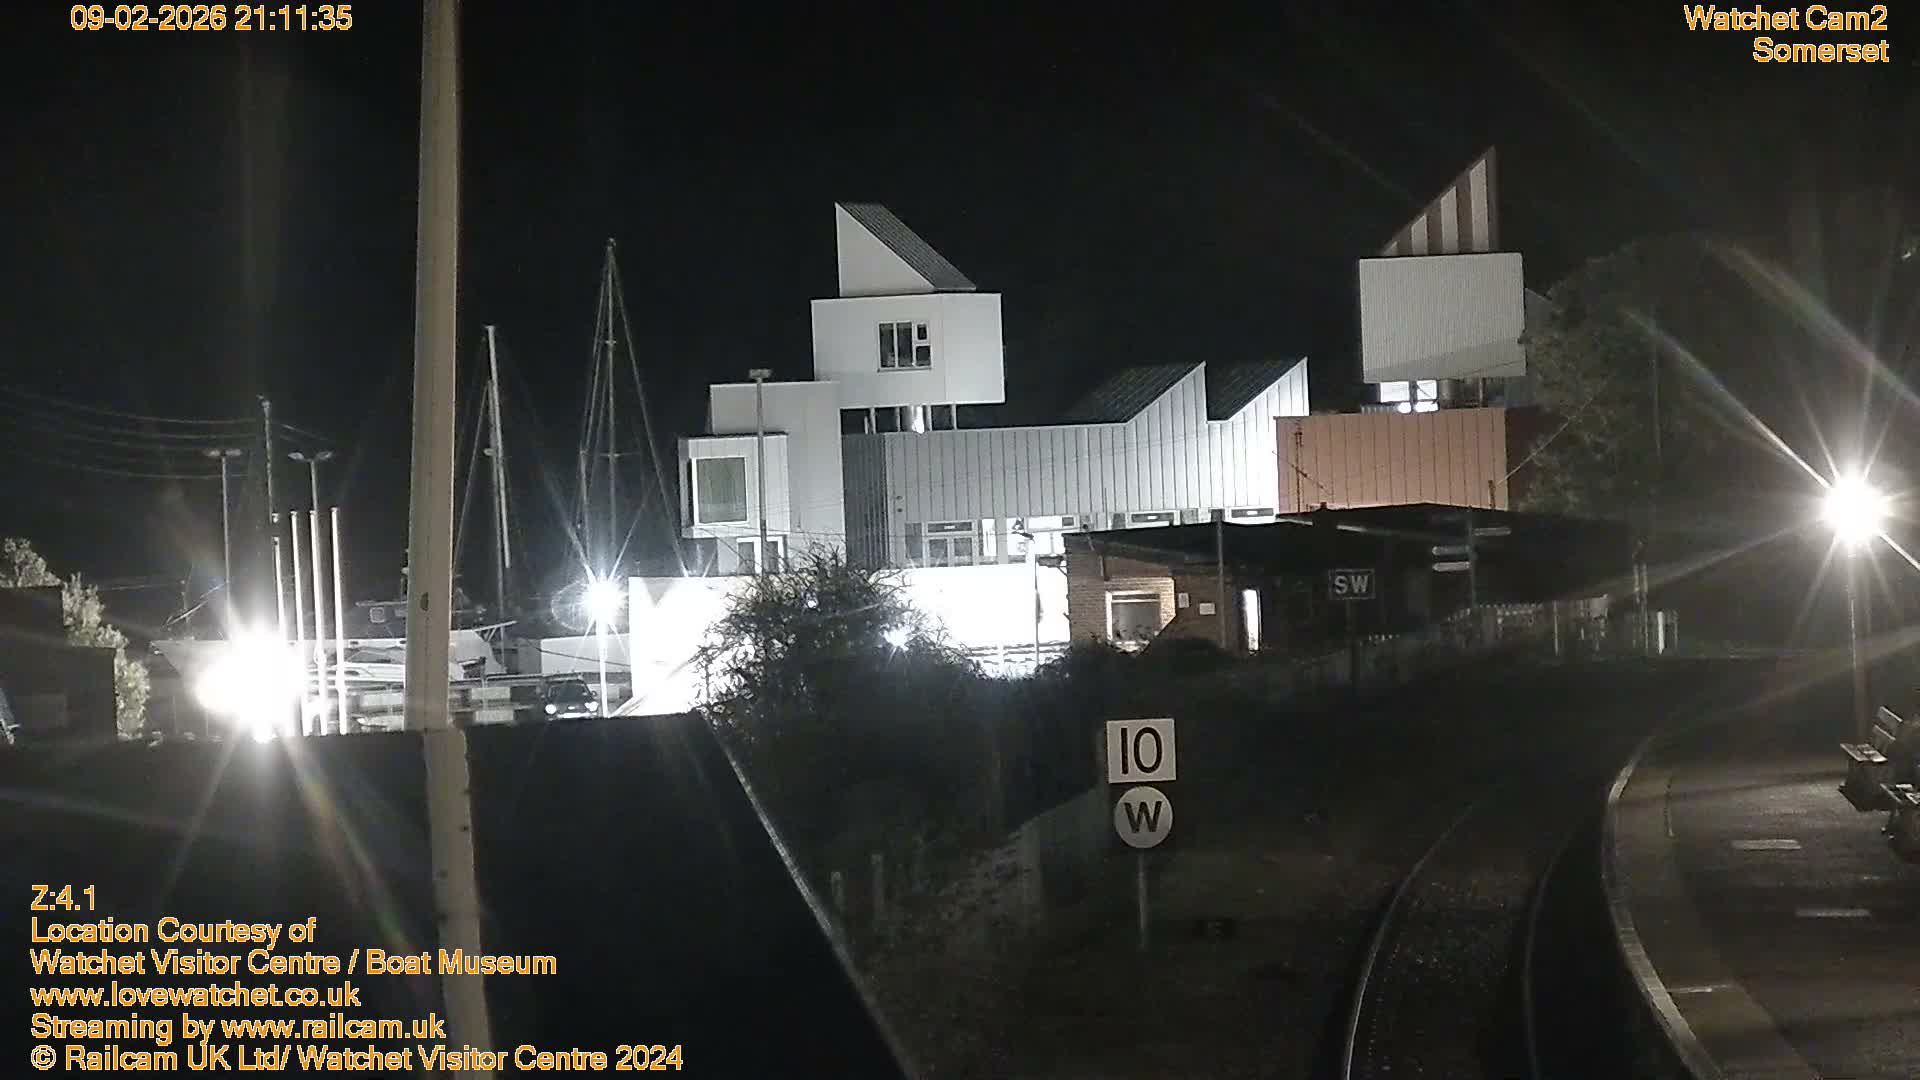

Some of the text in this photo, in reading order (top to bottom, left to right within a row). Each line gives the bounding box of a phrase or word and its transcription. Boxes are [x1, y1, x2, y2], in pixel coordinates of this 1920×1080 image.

[1334, 575, 1368, 593] SW
[1121, 727, 1162, 774] 10
[1124, 801, 1162, 833] W
